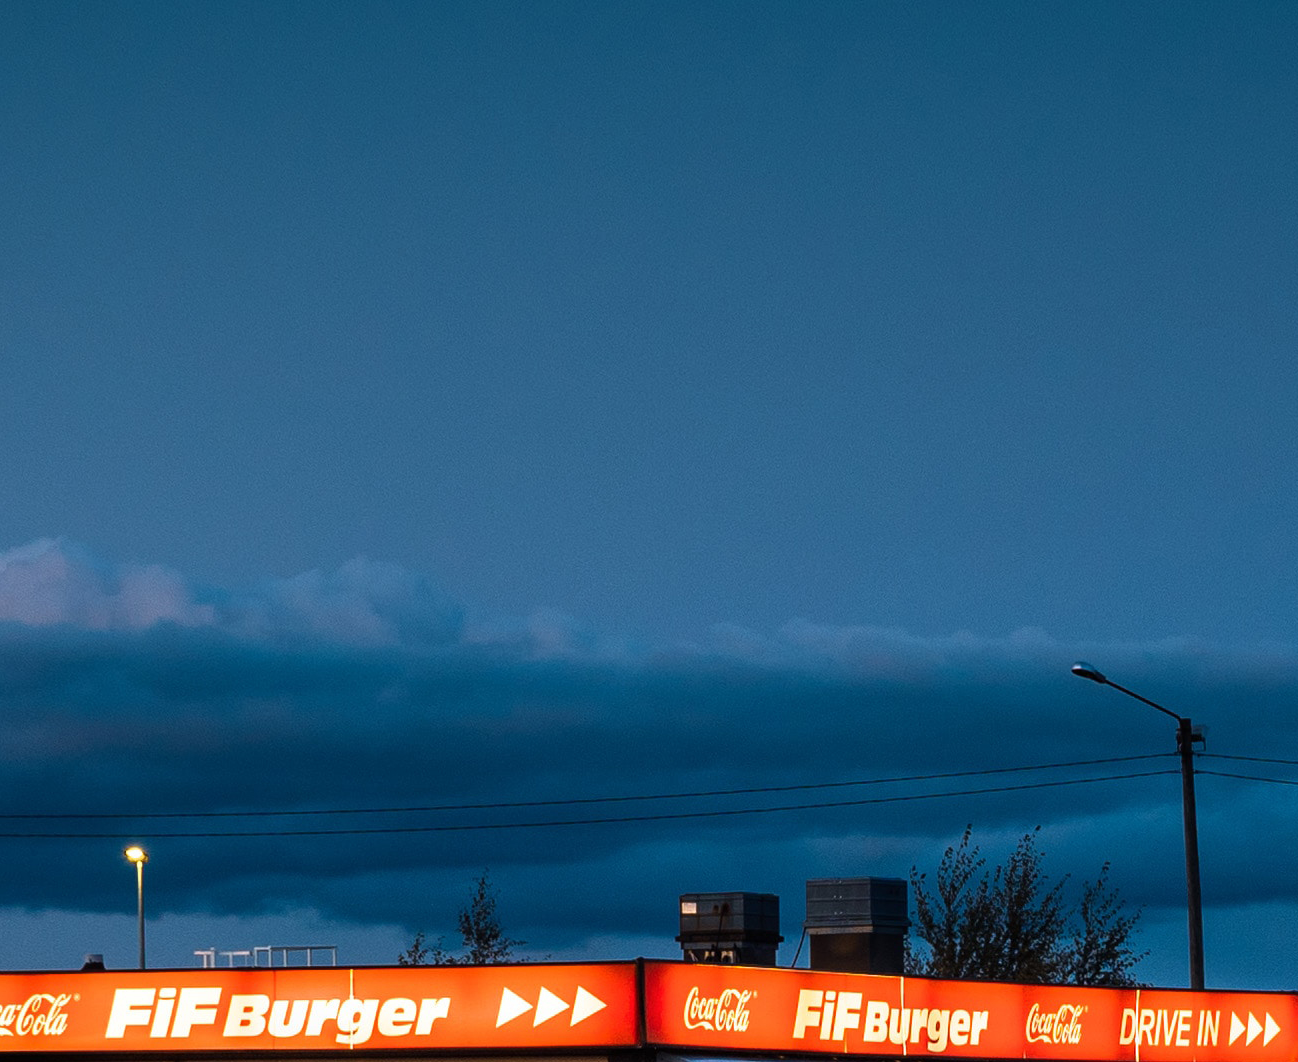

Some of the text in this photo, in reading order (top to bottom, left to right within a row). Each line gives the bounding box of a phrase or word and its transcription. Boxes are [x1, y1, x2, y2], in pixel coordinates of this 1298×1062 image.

[105, 987, 222, 1039] FiF
[222, 994, 452, 1045] Burger
[683, 986, 753, 1032] Coca-Cola
[793, 988, 863, 1041] FiF
[863, 1000, 989, 1053] Burger
[1025, 1002, 1084, 1045] Coca-Cola
[1119, 1008, 1192, 1047] DRIVE
[1196, 1010, 1221, 1047] IN
